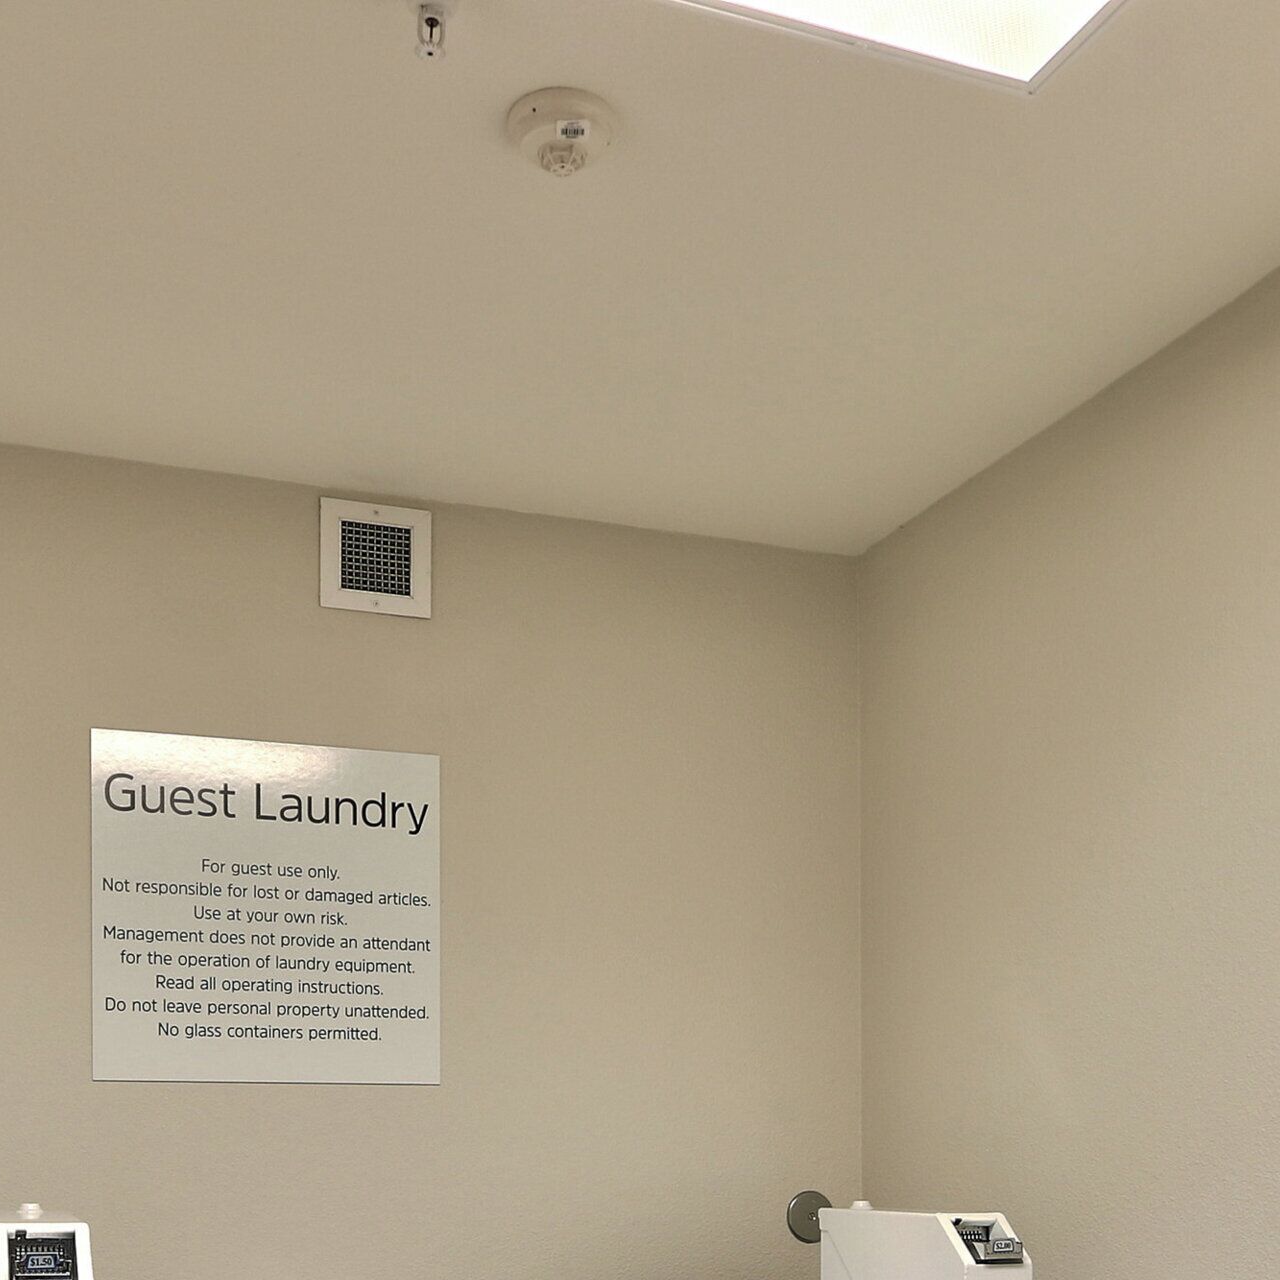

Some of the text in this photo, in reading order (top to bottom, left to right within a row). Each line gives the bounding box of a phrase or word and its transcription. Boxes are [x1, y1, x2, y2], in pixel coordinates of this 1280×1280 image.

[105, 773, 429, 835] Guest Laundry
[202, 859, 340, 881] For guest use only.
[103, 877, 431, 907] Not responsible for lost or damaged articles.
[194, 905, 347, 925] Use at your own risk.
[103, 925, 431, 952] Management does not provide an attendant
[120, 949, 415, 974] for the operation of laundry equipment.
[156, 975, 383, 995] Read all operating instructions.
[105, 997, 429, 1019] Do not leave personal property unattended.
[158, 1022, 381, 1041] No glass containers permitted.
[30, 1257, 53, 1267] $1.50
